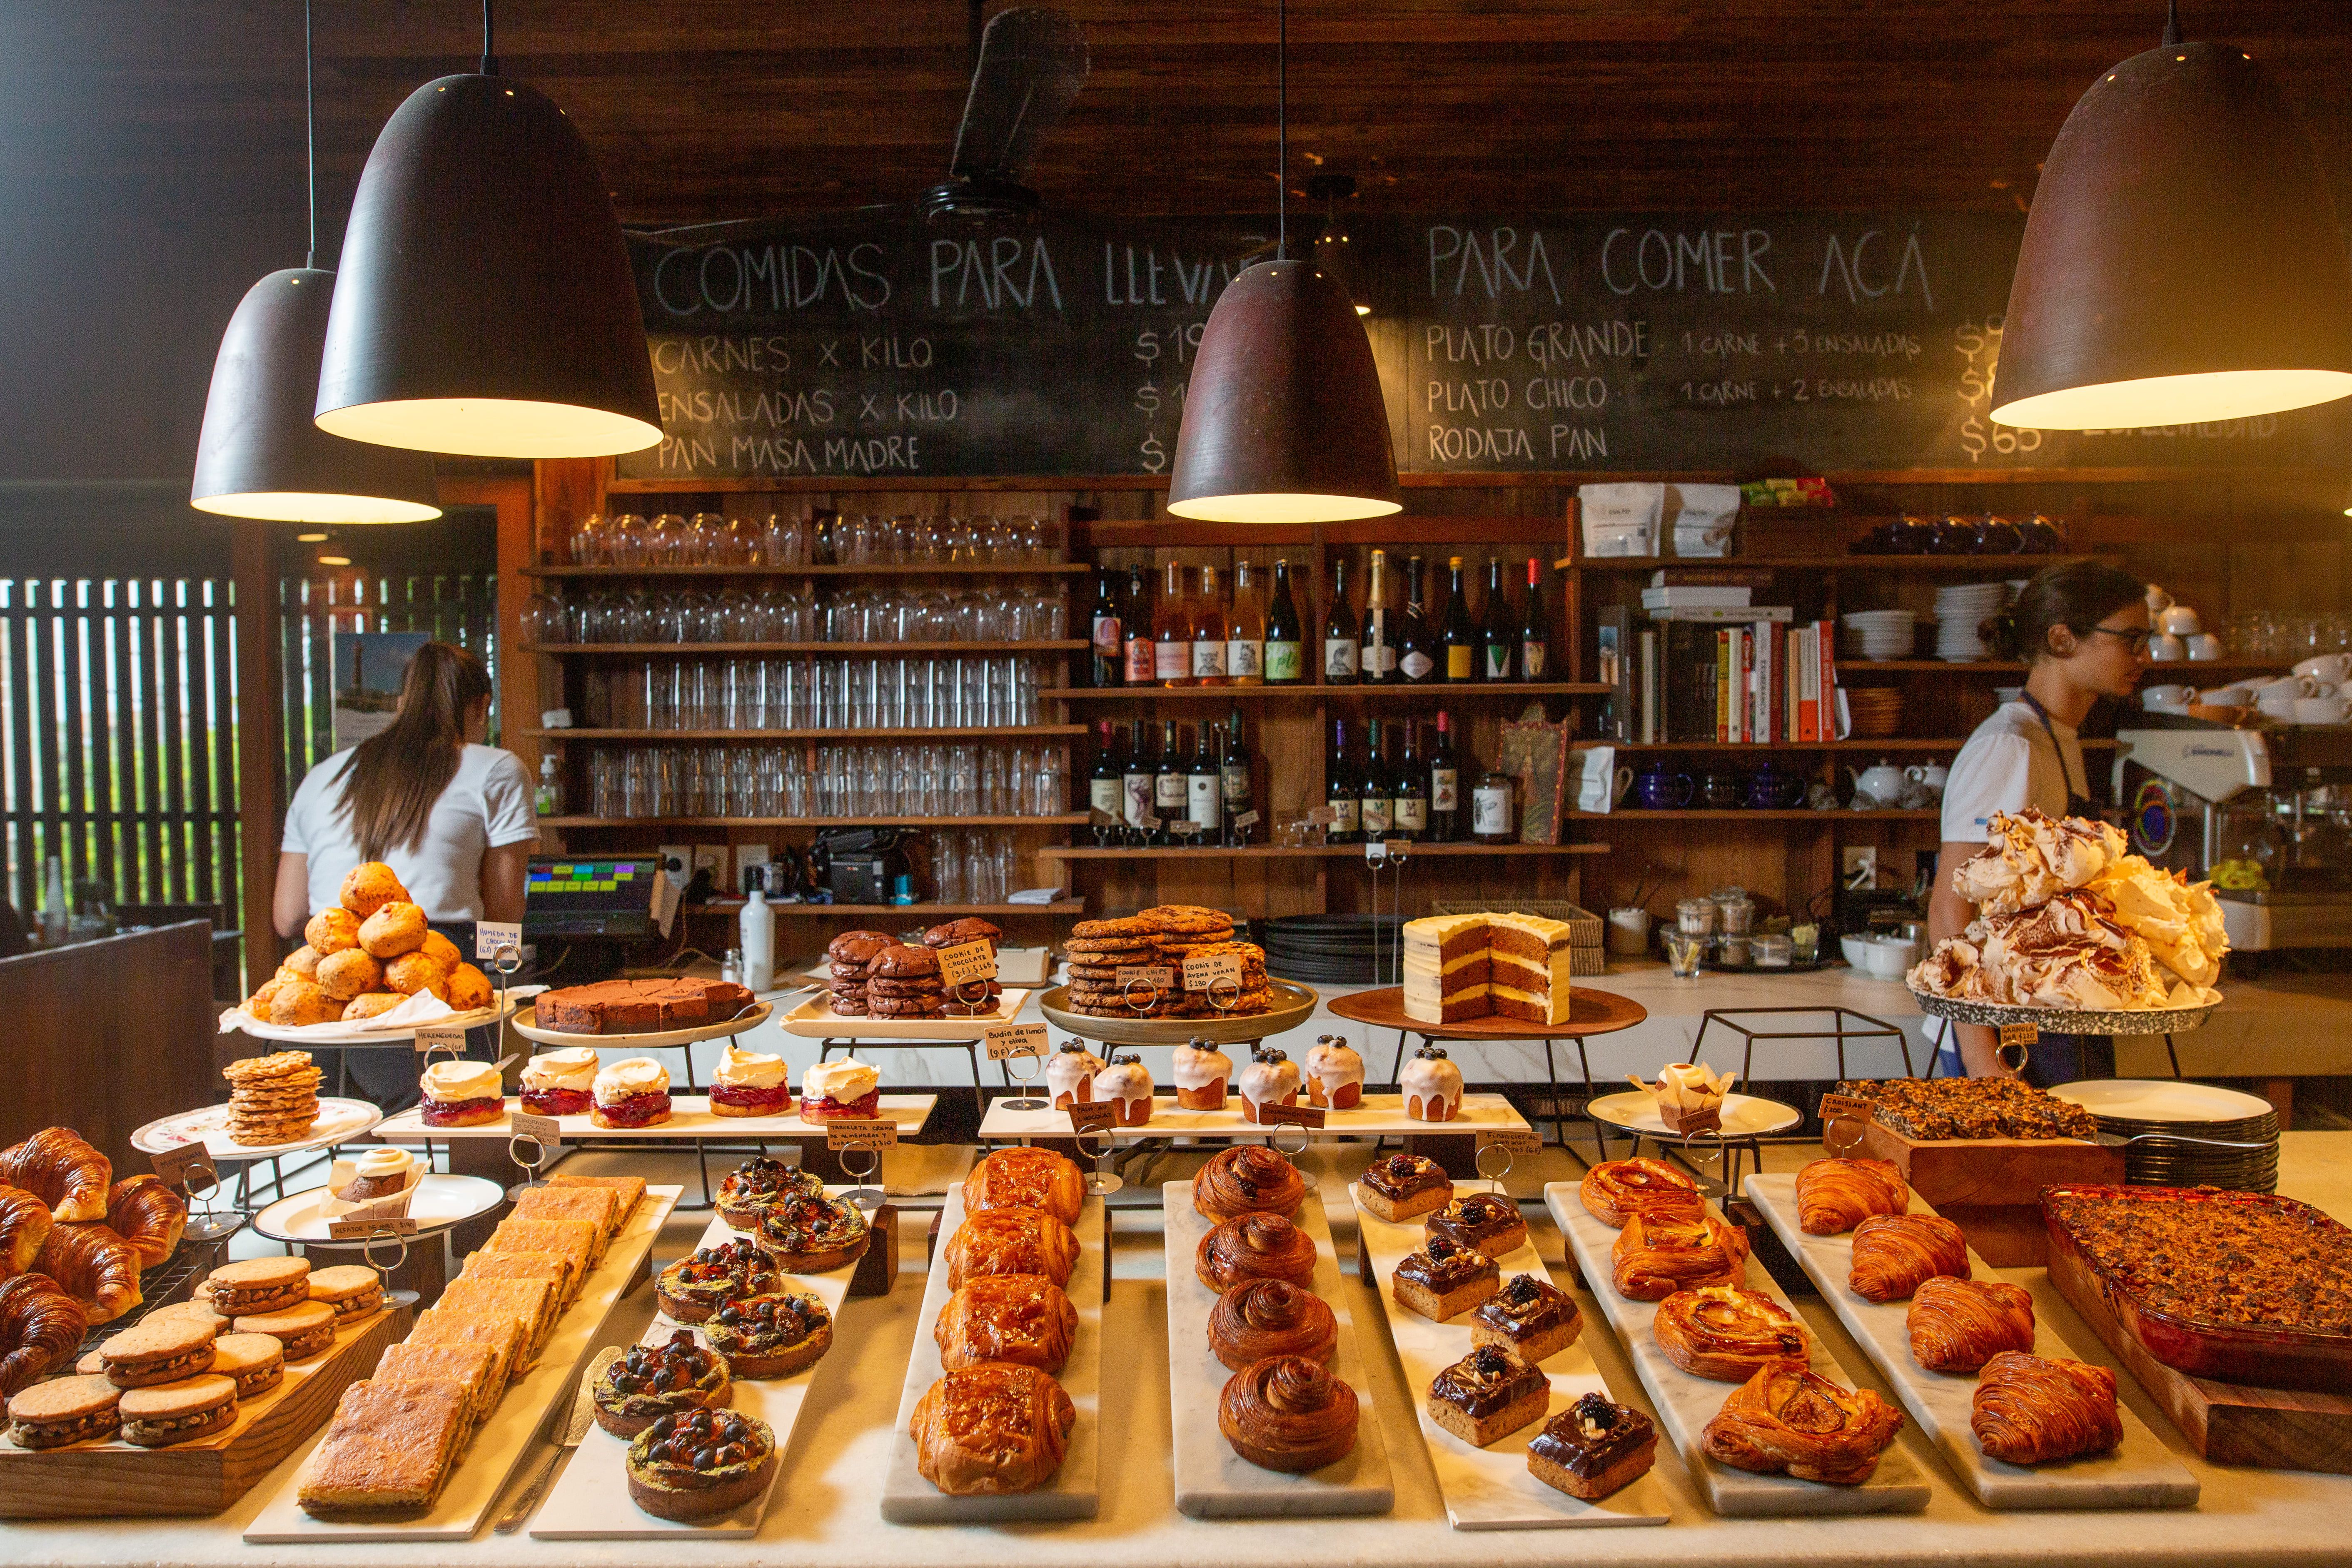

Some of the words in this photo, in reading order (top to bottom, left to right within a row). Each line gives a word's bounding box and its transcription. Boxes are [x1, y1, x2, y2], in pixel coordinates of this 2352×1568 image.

[654, 243, 891, 315] COMIDAS
[930, 237, 1062, 311] PARA
[1429, 225, 1562, 306] PARA
[1601, 228, 1777, 296] COMER
[1819, 220, 1933, 311] ACÁ
[655, 334, 791, 374] CARNES
[861, 337, 932, 370] KILO
[1427, 324, 1514, 367] PLATO
[1527, 321, 1649, 372] GRANDE
[1700, 332, 1761, 360] CARNE
[1816, 334, 1921, 361] ENSALADAS
[659, 389, 833, 427] ENSALADAS
[897, 389, 958, 421] KILO
[1427, 377, 1510, 417] PLATO
[1525, 376, 1607, 411] CHICO
[1699, 380, 1756, 406] CARNE
[659, 434, 717, 471] PAN
[732, 436, 817, 474] MASA
[825, 436, 920, 475] MADRE
[1429, 424, 1535, 462] RODAJA
[1551, 423, 1609, 461] PAN
[480, 927, 505, 937] HUMEDA
[948, 955, 987, 968] CHOCOLATE
[1212, 967, 1235, 975] VEGAN
[1025, 1026, 1047, 1035] limón
[514, 1117, 547, 1127] CUADRADO
